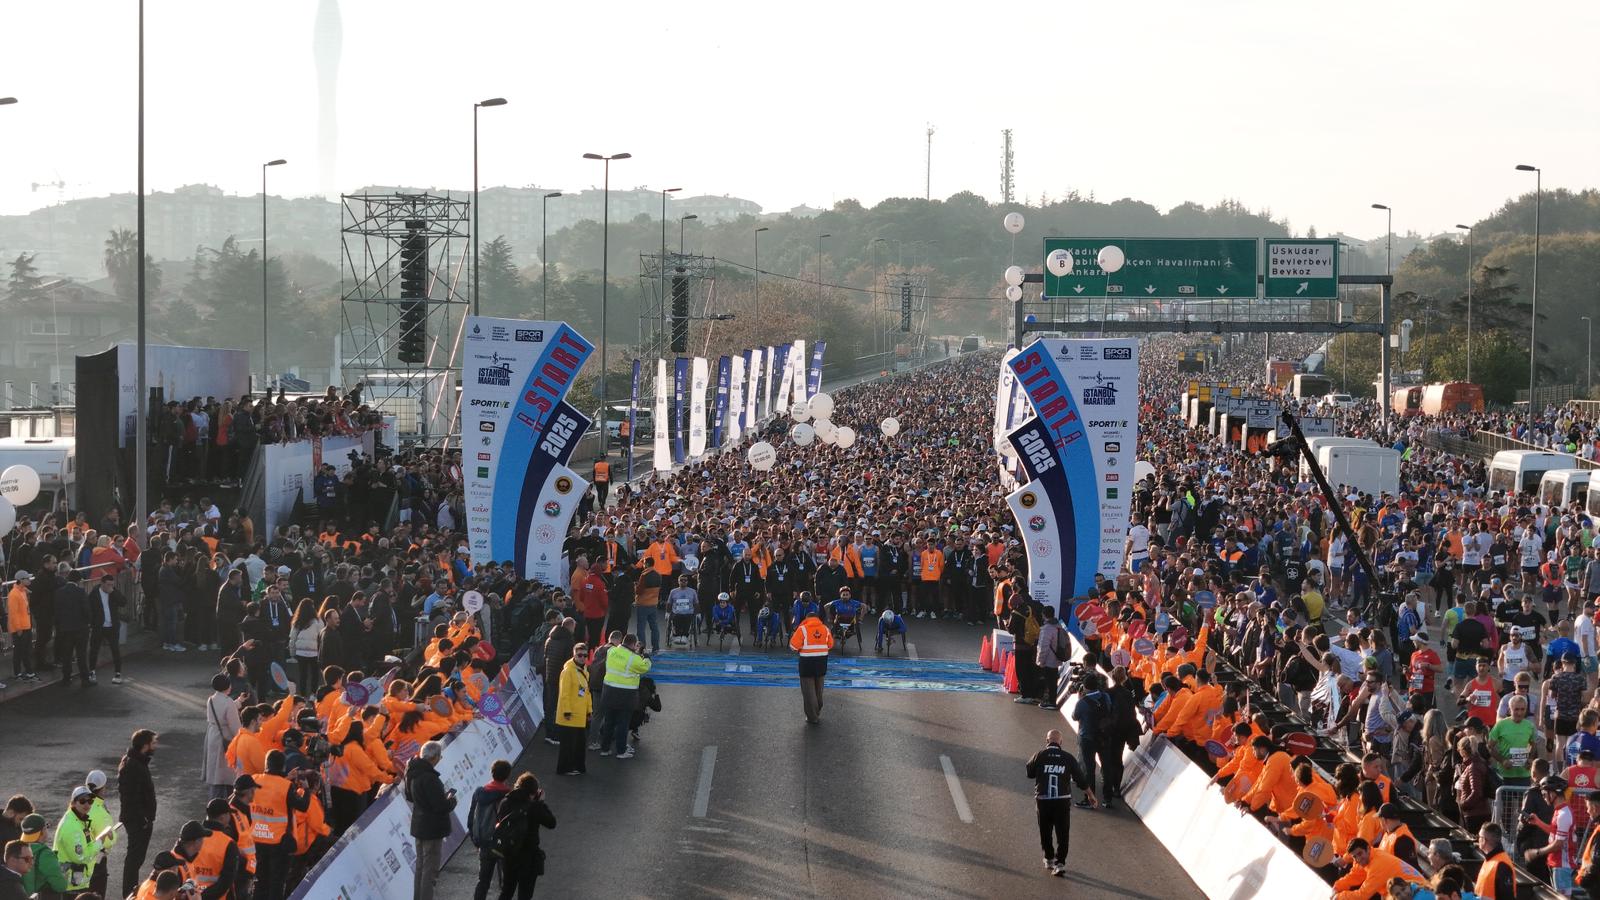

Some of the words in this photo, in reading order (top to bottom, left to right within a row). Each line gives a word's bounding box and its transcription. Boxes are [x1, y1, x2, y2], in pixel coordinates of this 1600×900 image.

[1272, 257, 1332, 267] Beylerbeyi
[1068, 268, 1107, 276] Ankara
[1272, 268, 1311, 276] Beykoz
[524, 332, 588, 413] START
[1013, 351, 1078, 431] START
[1083, 397, 1116, 406] MARATHON
[540, 412, 579, 459] 2025
[1018, 429, 1057, 474] 2025
[1044, 764, 1066, 774] TEAM
